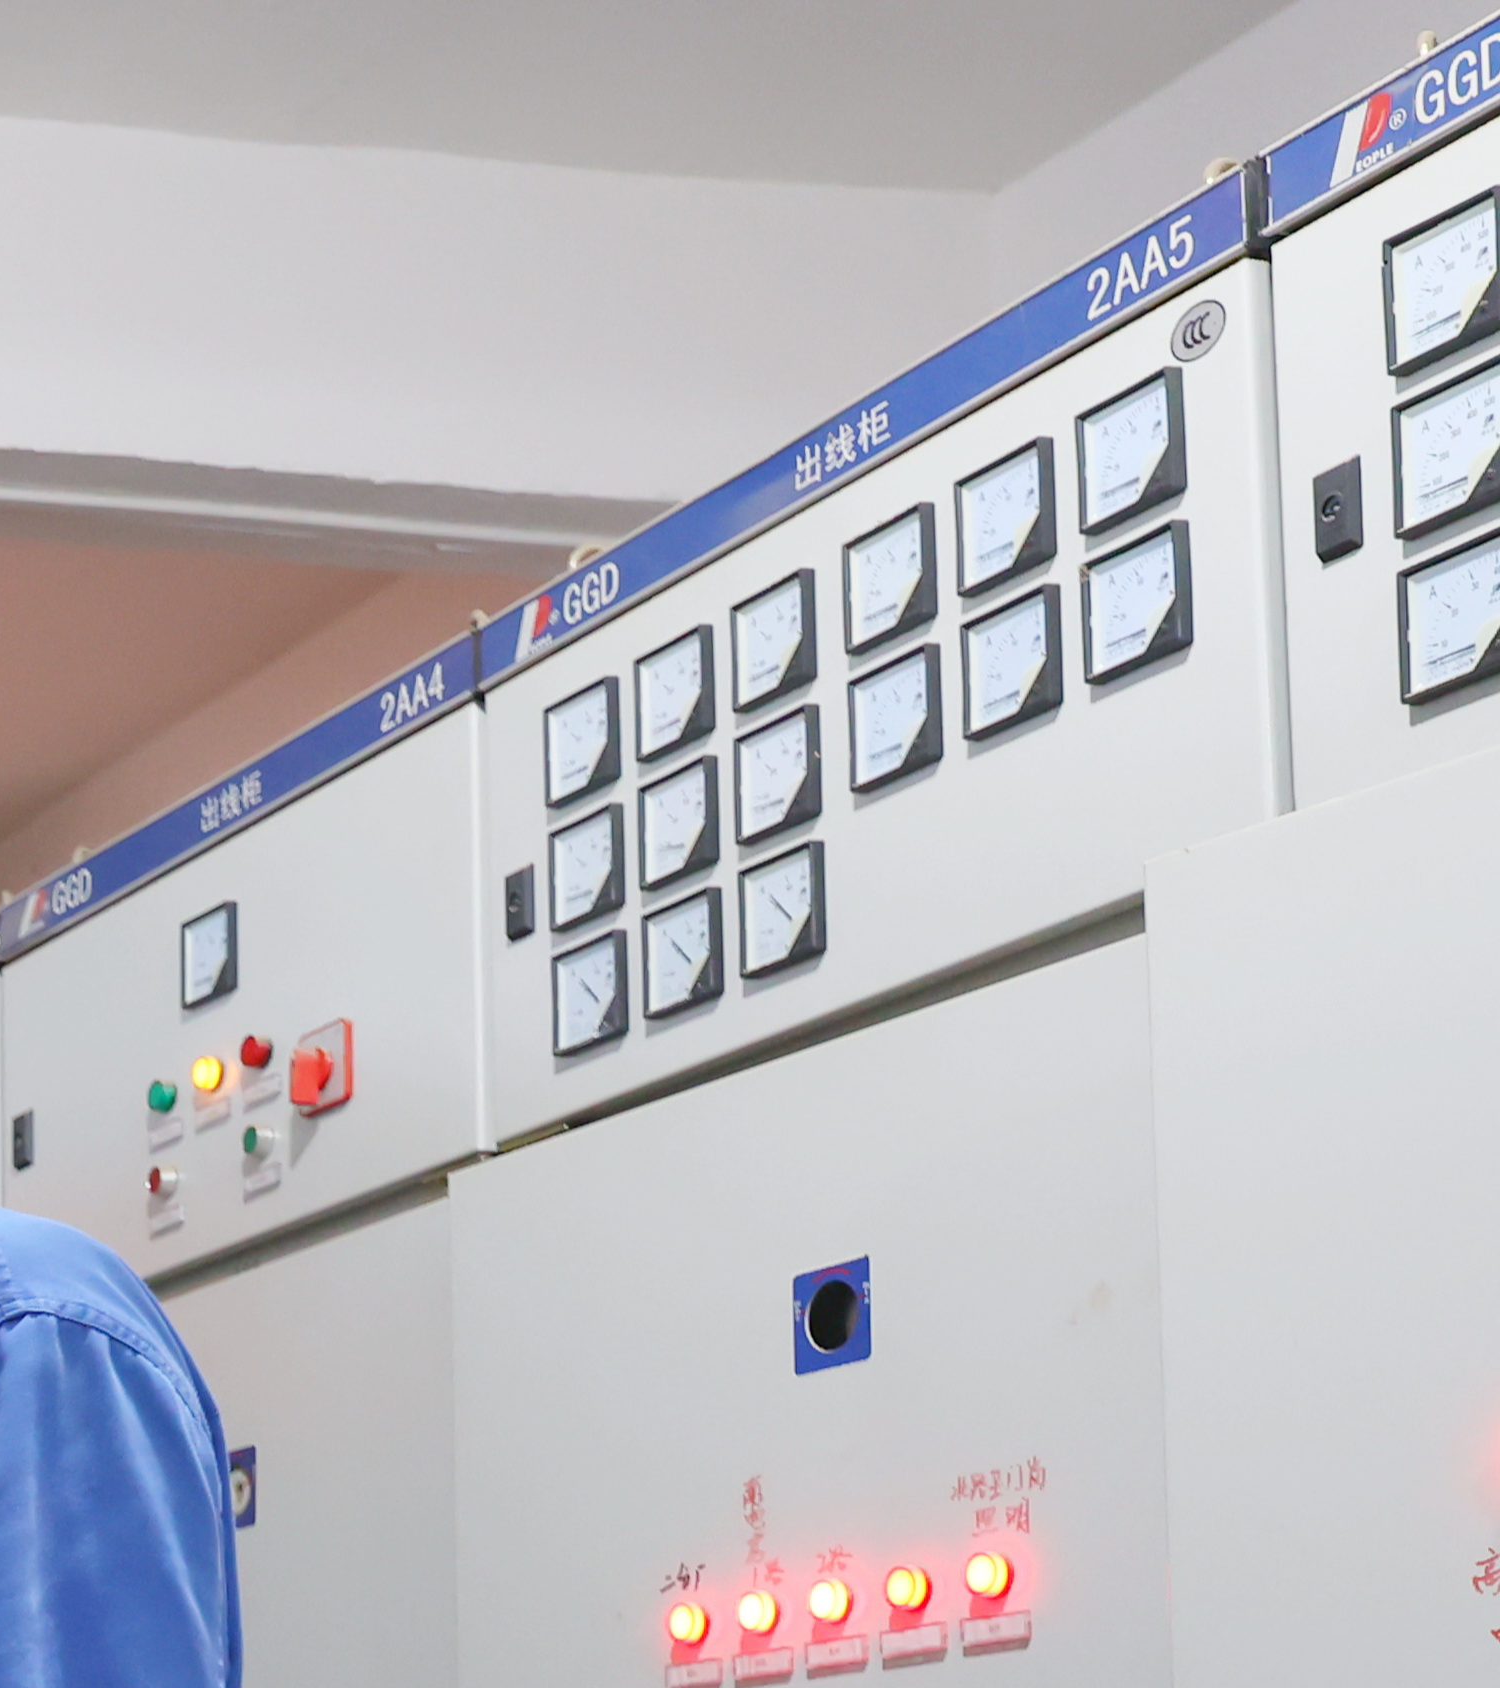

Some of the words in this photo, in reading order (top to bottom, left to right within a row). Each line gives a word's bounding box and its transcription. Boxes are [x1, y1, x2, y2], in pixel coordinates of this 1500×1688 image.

[1087, 214, 1195, 321] 2AA5
[794, 400, 892, 491] 出线柜
[562, 562, 620, 625] GGD
[380, 662, 446, 733] 2AA4
[51, 867, 93, 916] GGD
